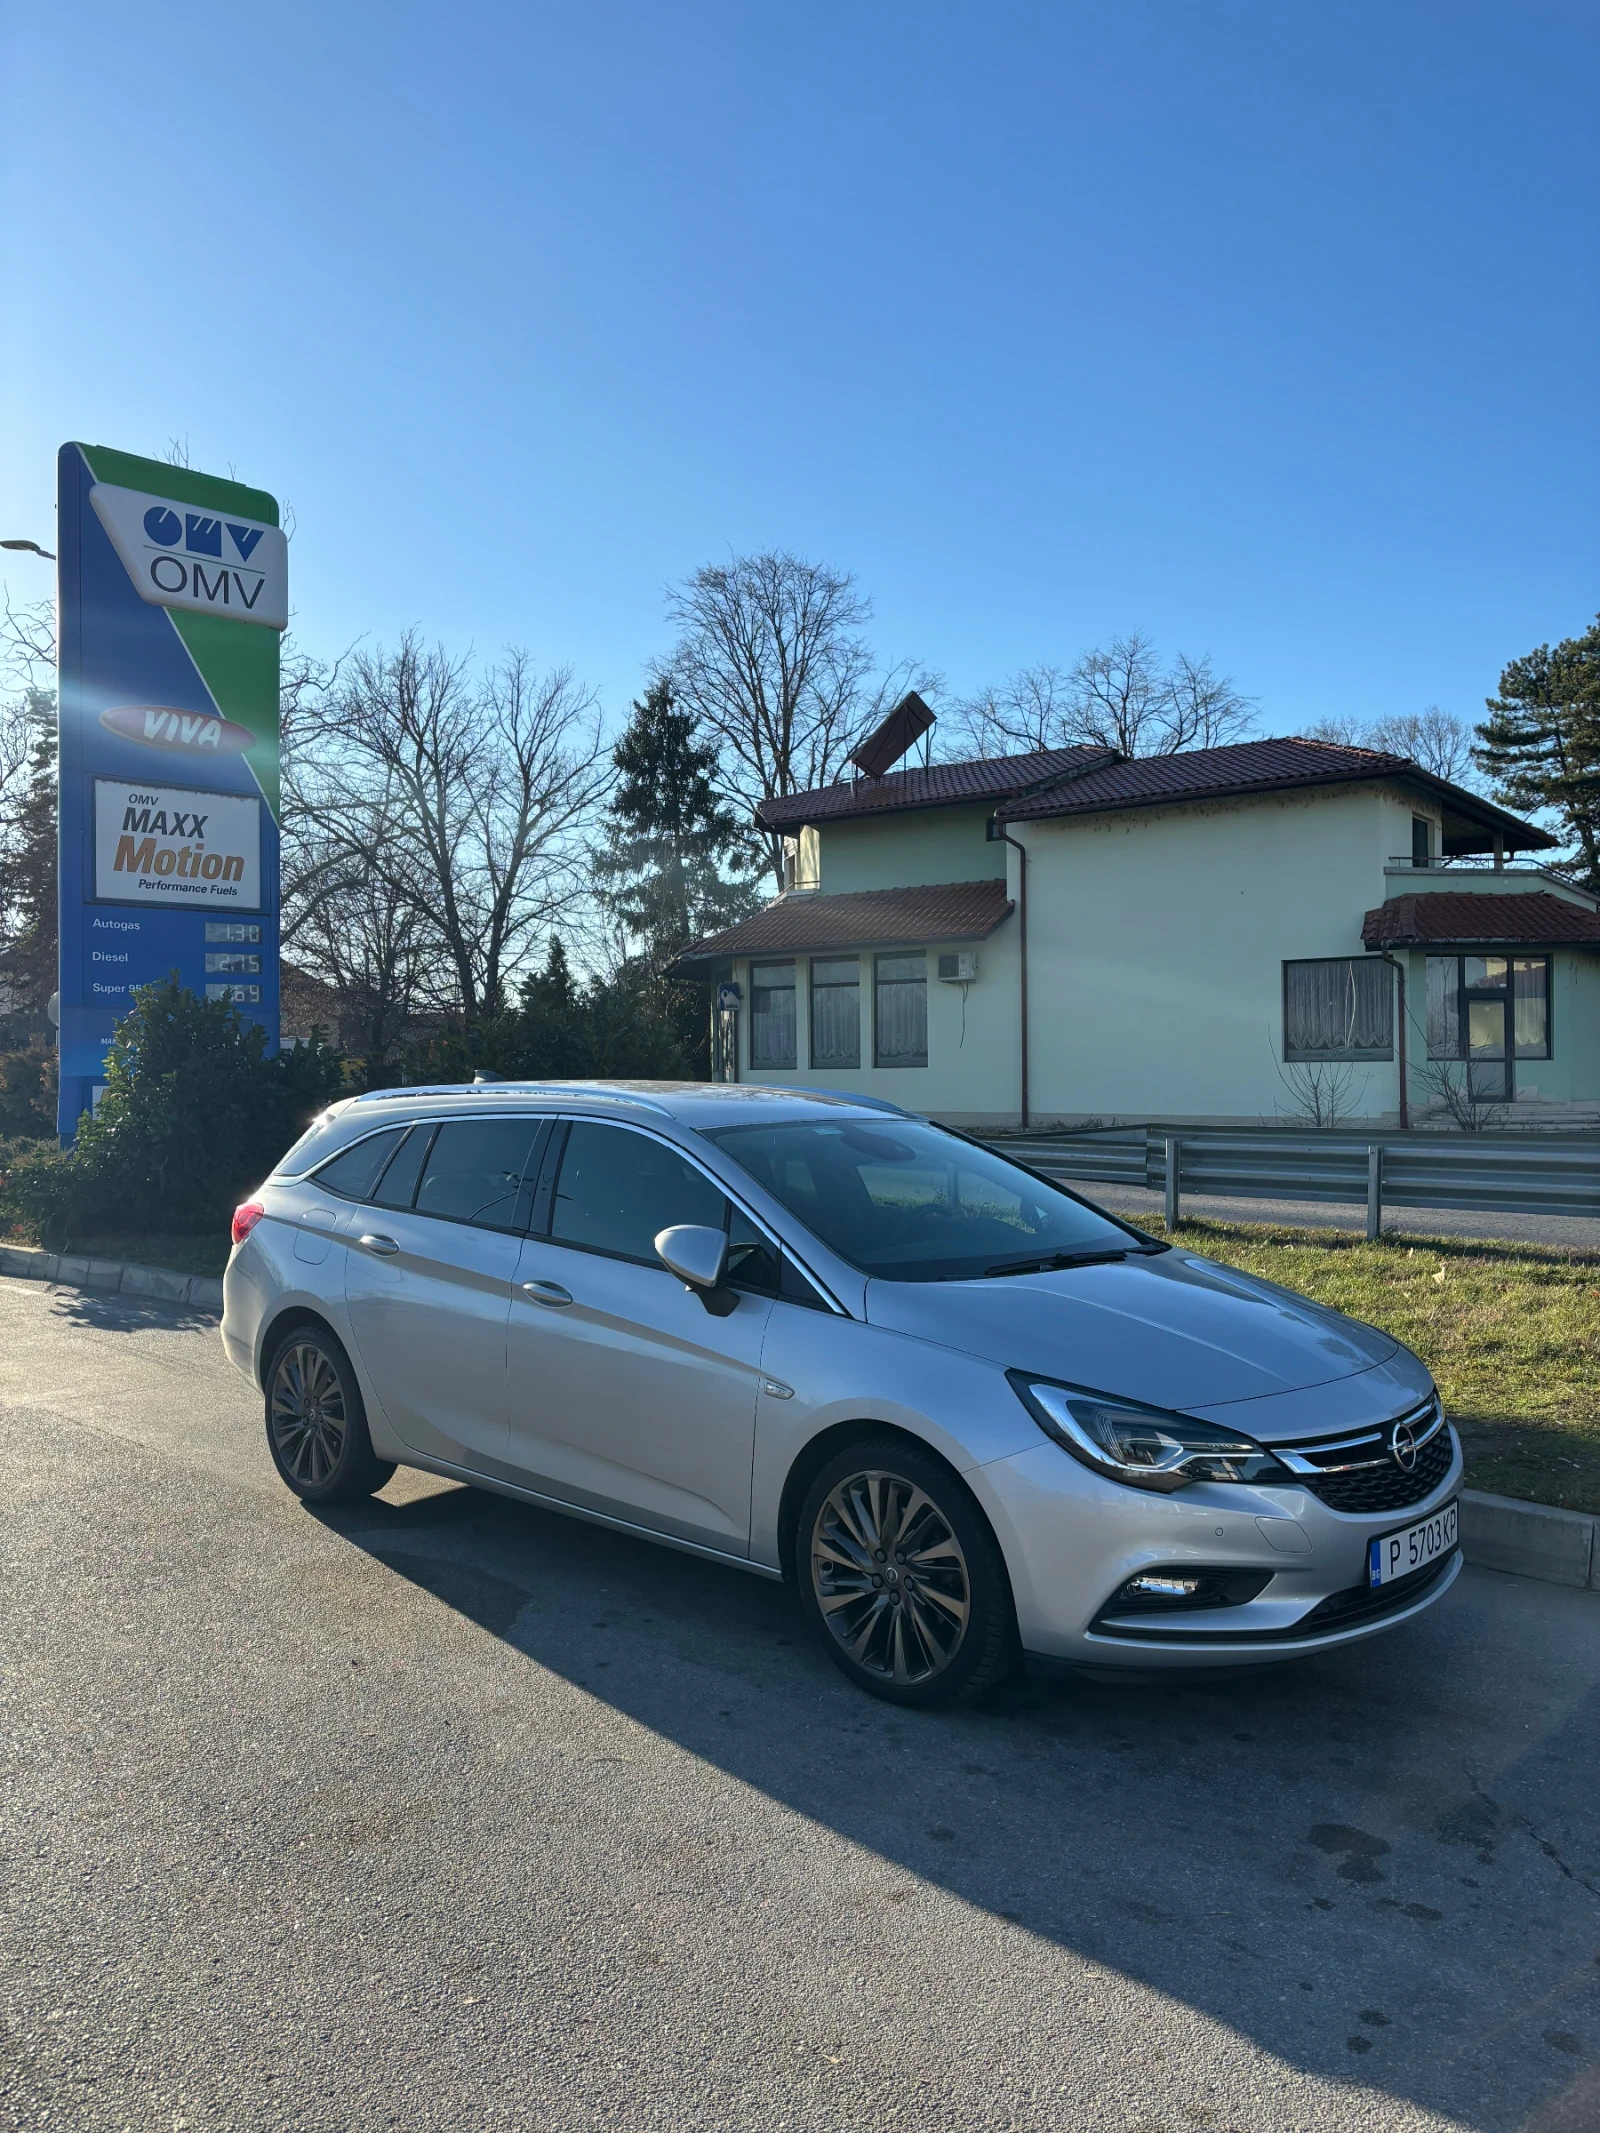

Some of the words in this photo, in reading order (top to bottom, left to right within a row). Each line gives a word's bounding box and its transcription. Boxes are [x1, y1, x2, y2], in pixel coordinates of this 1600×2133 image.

[150, 556, 266, 610] OMV
[143, 710, 222, 749] VIVA
[128, 793, 159, 806] OMV
[122, 806, 209, 839] MAXX
[113, 835, 245, 882] Motion
[138, 879, 208, 894] Performance
[209, 884, 238, 896] Fuels
[92, 918, 141, 931] Autogas
[226, 923, 259, 942] 1,30
[92, 951, 128, 963] Diesel
[92, 983, 126, 995] Super
[1389, 1539, 1400, 1574] P
[1371, 1569, 1381, 1581] BG
